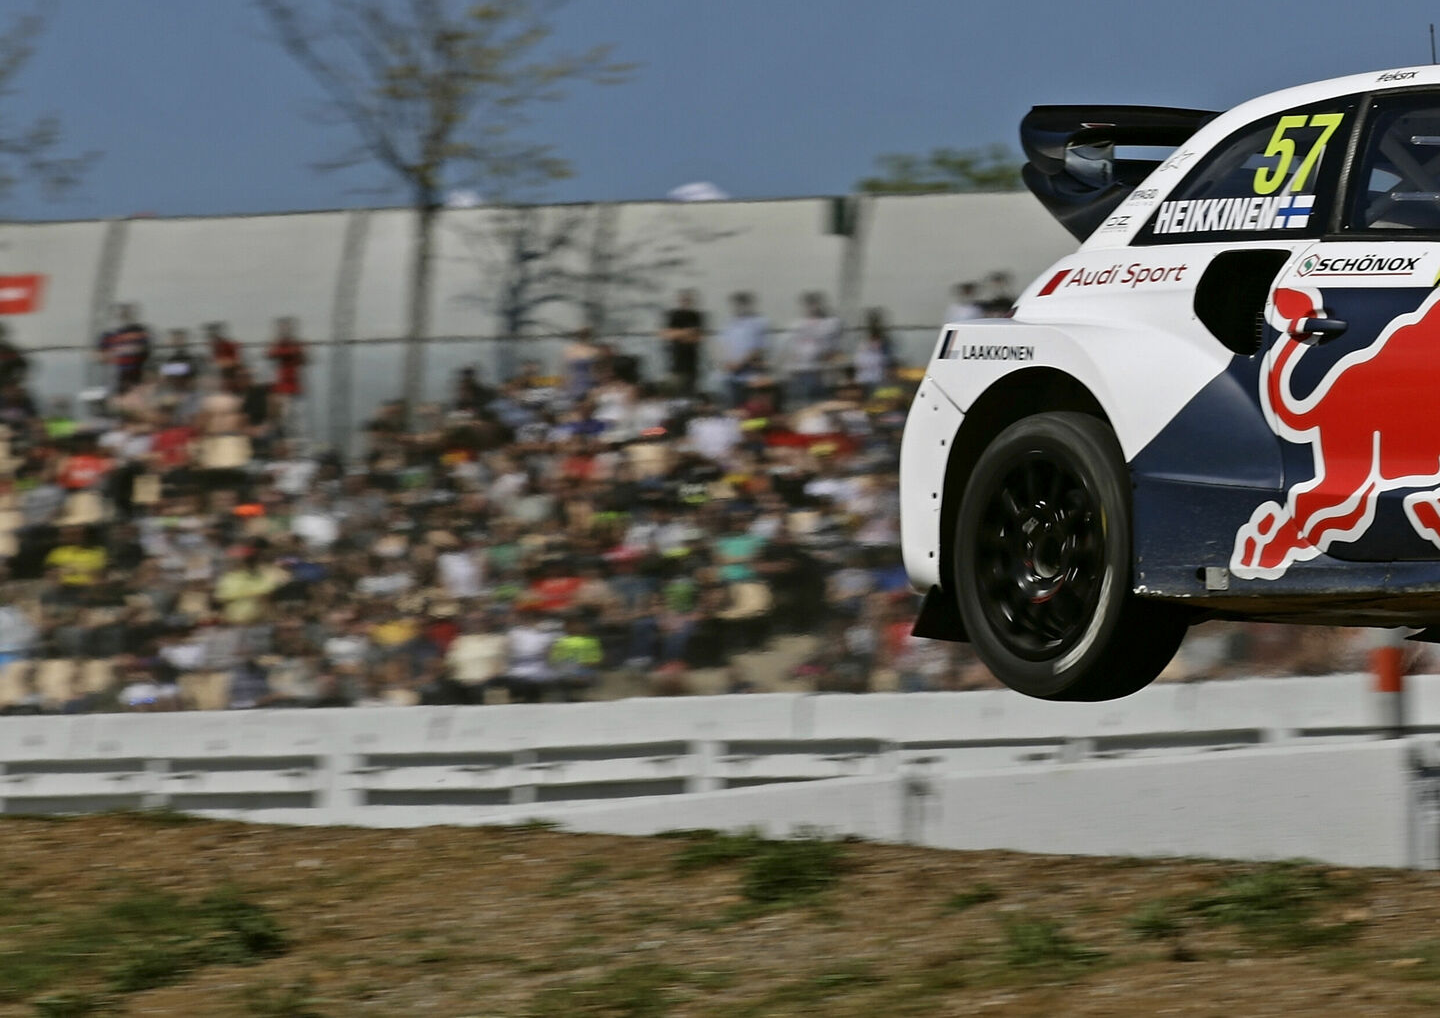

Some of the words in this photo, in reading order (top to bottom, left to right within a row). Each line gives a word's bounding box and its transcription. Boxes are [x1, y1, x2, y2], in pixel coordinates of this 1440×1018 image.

[1253, 113, 1344, 195] 57
[1153, 197, 1281, 234] HEIKKINEN
[1064, 264, 1122, 288] Audi
[1120, 263, 1188, 289] Sport
[1315, 255, 1421, 272] SCHÖNOX
[962, 345, 1034, 361] LAAKKONEN
